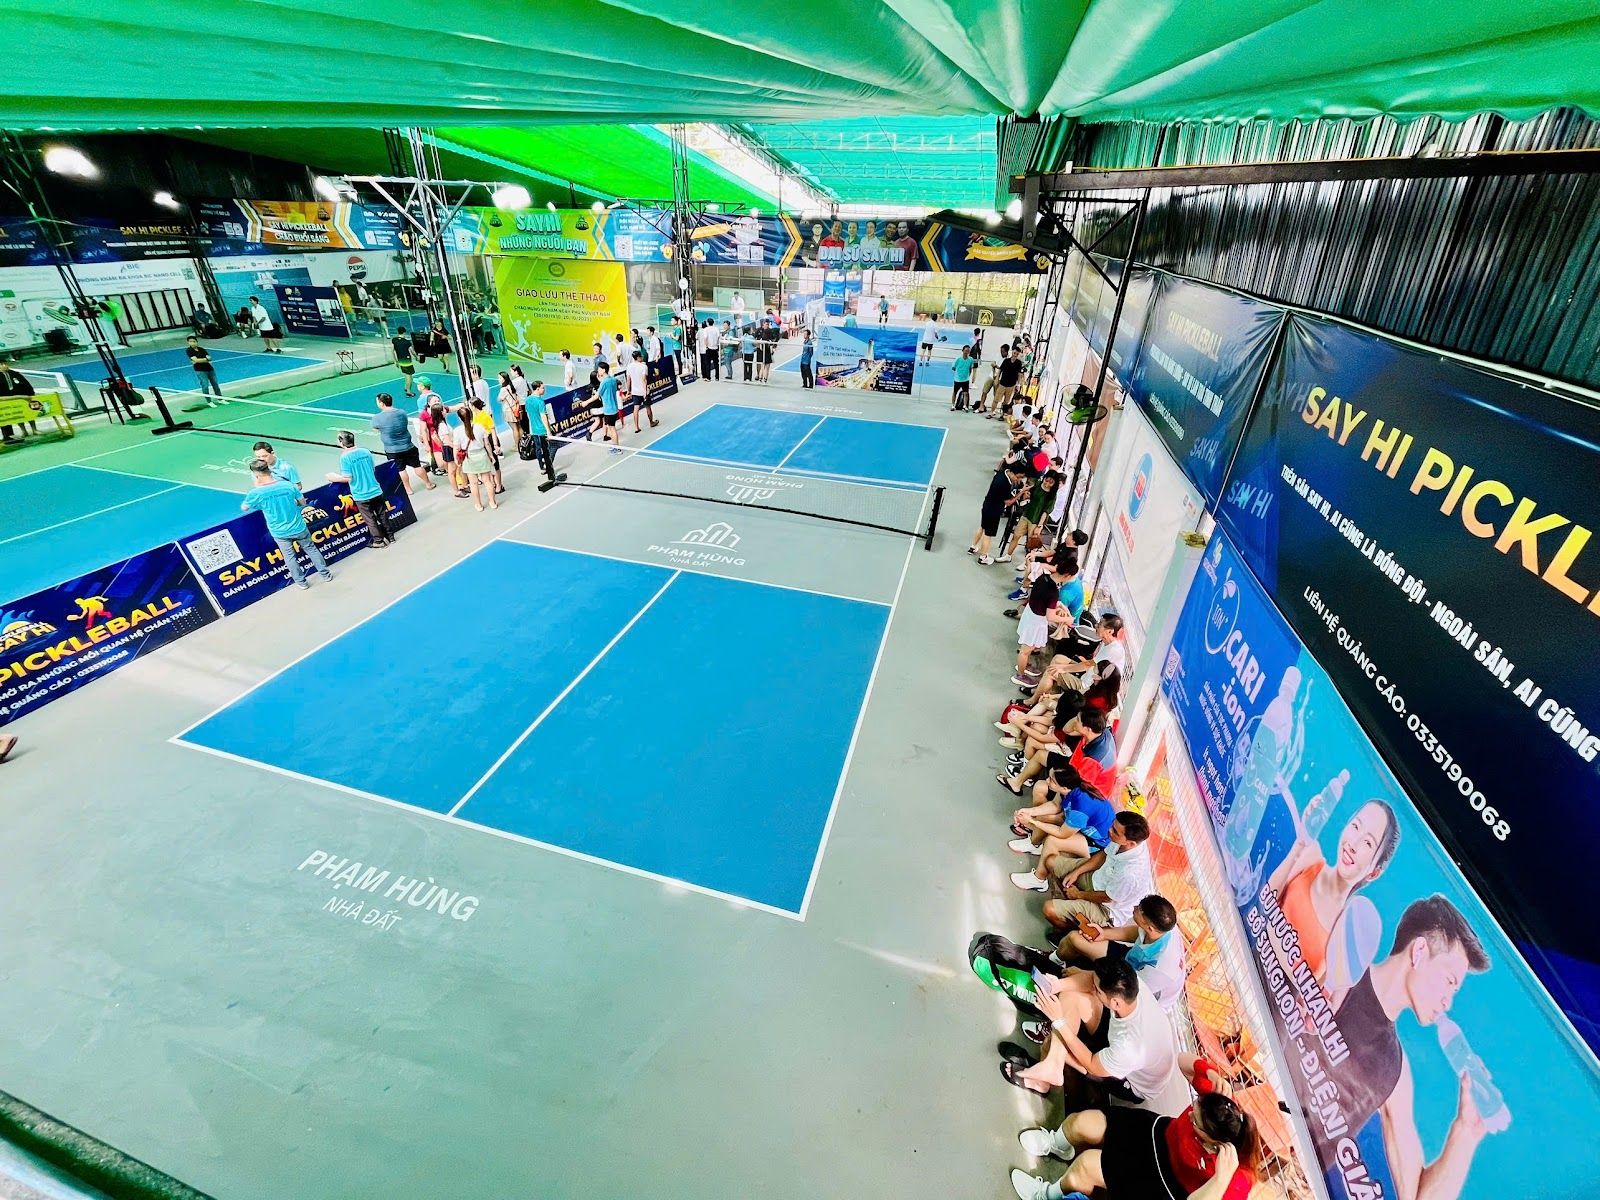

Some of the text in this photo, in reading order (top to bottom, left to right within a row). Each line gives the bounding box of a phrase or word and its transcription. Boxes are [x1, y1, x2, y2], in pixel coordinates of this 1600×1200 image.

[566, 239, 588, 258] BẠN
[819, 245, 906, 266] ĐẠI SỨ SAY HI
[516, 288, 538, 298] GIAO
[540, 289, 558, 299] LƯU
[1226, 479, 1257, 510] SAY
[1250, 488, 1274, 520] HI
[1301, 387, 1368, 447] SAY
[1360, 418, 1414, 479] HI
[1409, 447, 1600, 617] PICKL
[218, 547, 285, 586] SAY H
[647, 544, 747, 567] PHẠM HÙNG
[223, 581, 247, 599] ĐÁNH
[0, 596, 183, 687] PICKLEBALL
[34, 621, 58, 637] HI
[1307, 489, 1323, 509] SAY
[1319, 499, 1332, 521] HI,
[1330, 510, 1343, 528] AI
[1360, 537, 1377, 560] LÀ
[1401, 574, 1427, 605] ĐỘI
[1430, 600, 1479, 651] NGOÀI
[1473, 640, 1515, 689] SÂN,
[1512, 677, 1543, 708] AI
[1537, 698, 1600, 763] CŨNG
[18, 678, 38, 693] RA
[36, 659, 79, 683] NHỮNG
[78, 649, 100, 665] MỐI
[99, 635, 130, 654] QUAN
[129, 628, 145, 642] HỆ
[144, 618, 171, 634] CHÂN
[1225, 629, 1267, 705] CARI
[10, 688, 49, 711] QUẢNG
[49, 676, 72, 692] CÁO
[1303, 585, 1512, 842] LIÊN HỆ QUẢNG CÁO: 0335190068
[297, 850, 480, 922] PHẠM HÙNG
[322, 896, 403, 931] NHÀ ĐẤT
[1267, 907, 1301, 966] NƯỚC
[1301, 1049, 1349, 1140] ĐIỆN
